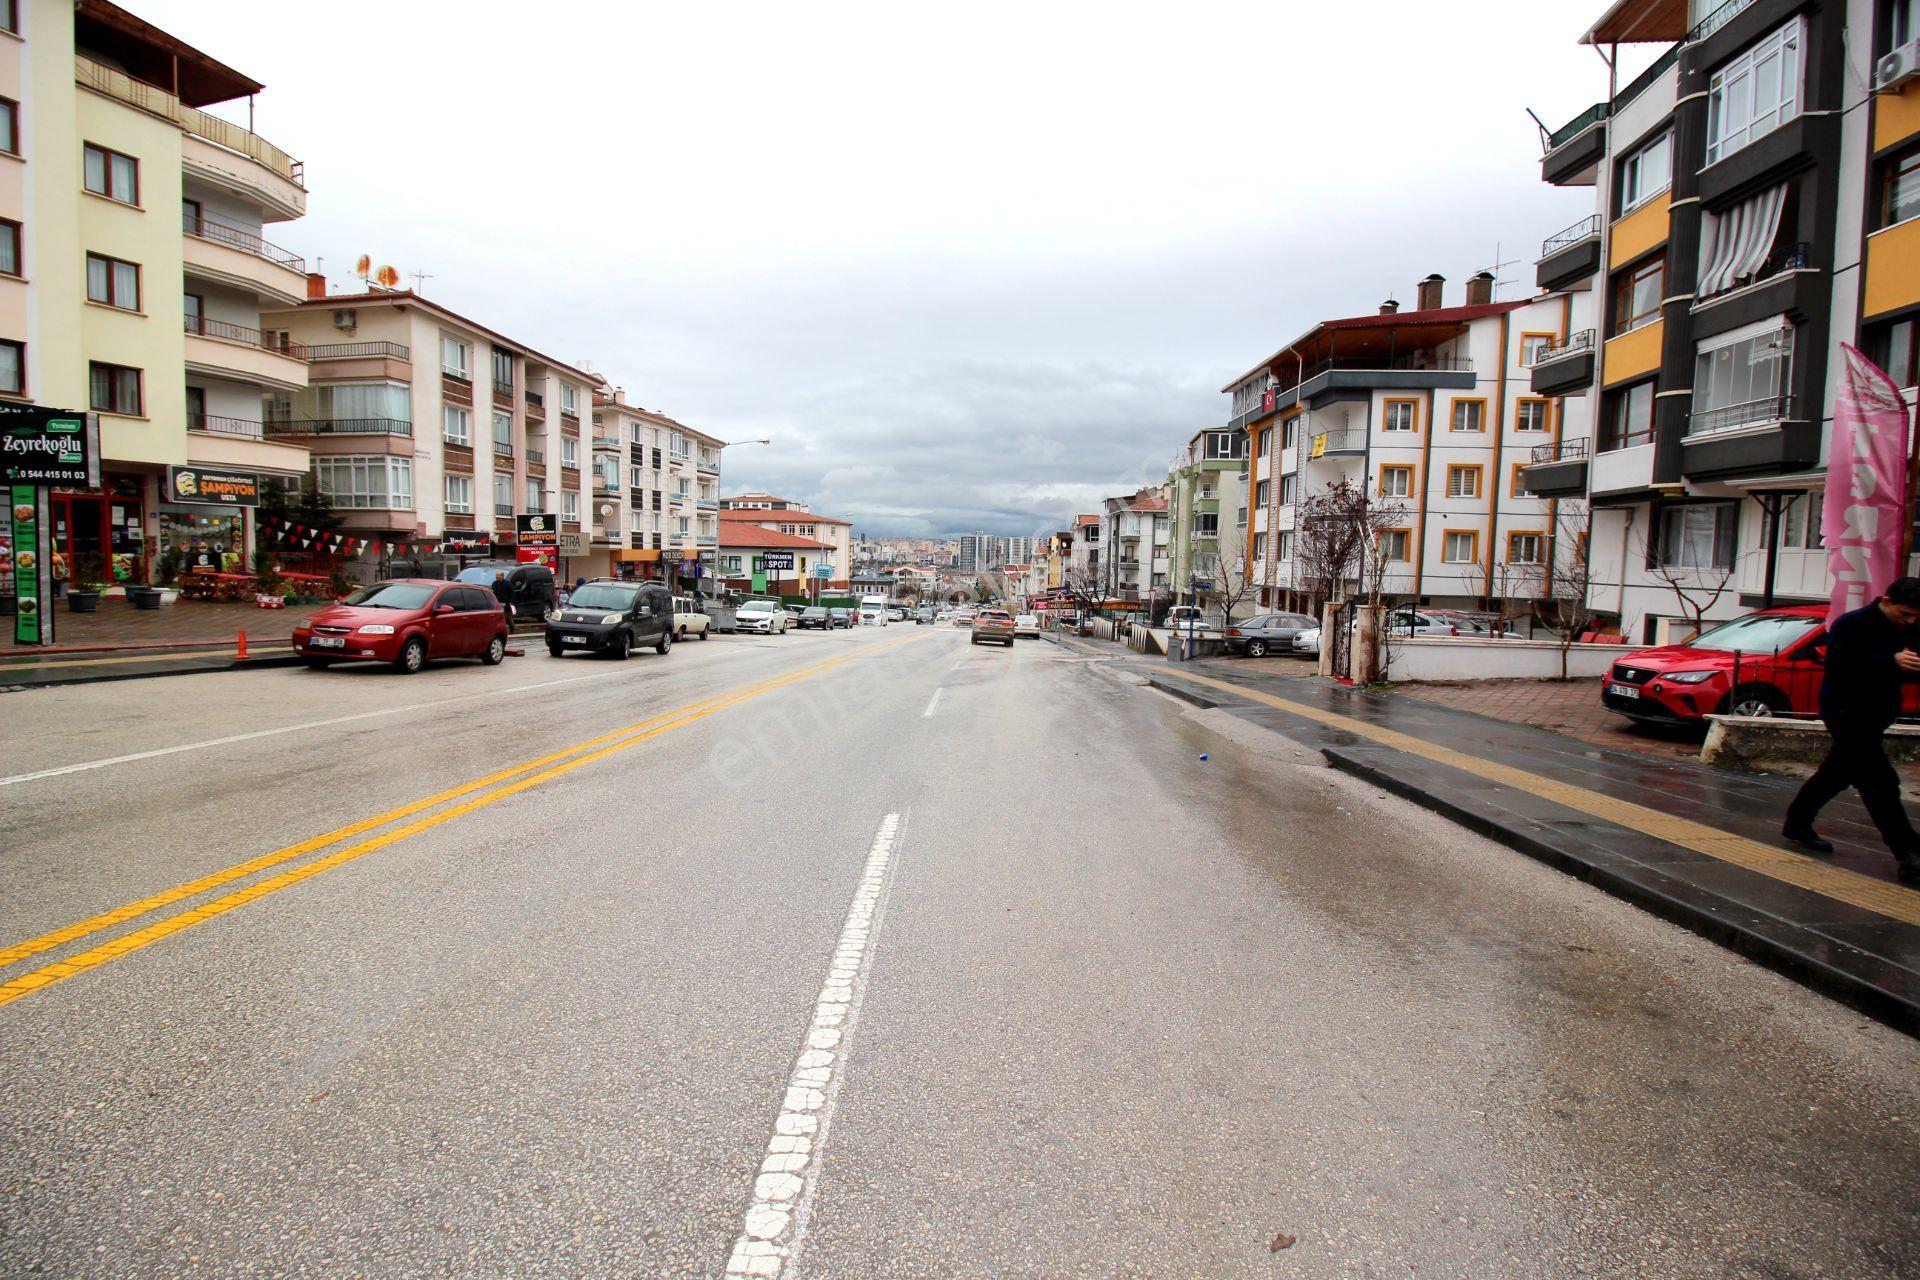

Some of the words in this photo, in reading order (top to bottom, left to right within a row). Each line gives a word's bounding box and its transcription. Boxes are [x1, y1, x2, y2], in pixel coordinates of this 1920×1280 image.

[3, 434, 82, 456] Zeyrekoğlu
[28, 470, 43, 478] 544
[45, 470, 60, 478] 415
[62, 471, 72, 479] 01
[74, 471, 85, 479] 03
[764, 553, 793, 561] TÜRKMEN
[768, 560, 788, 569] SPOT
